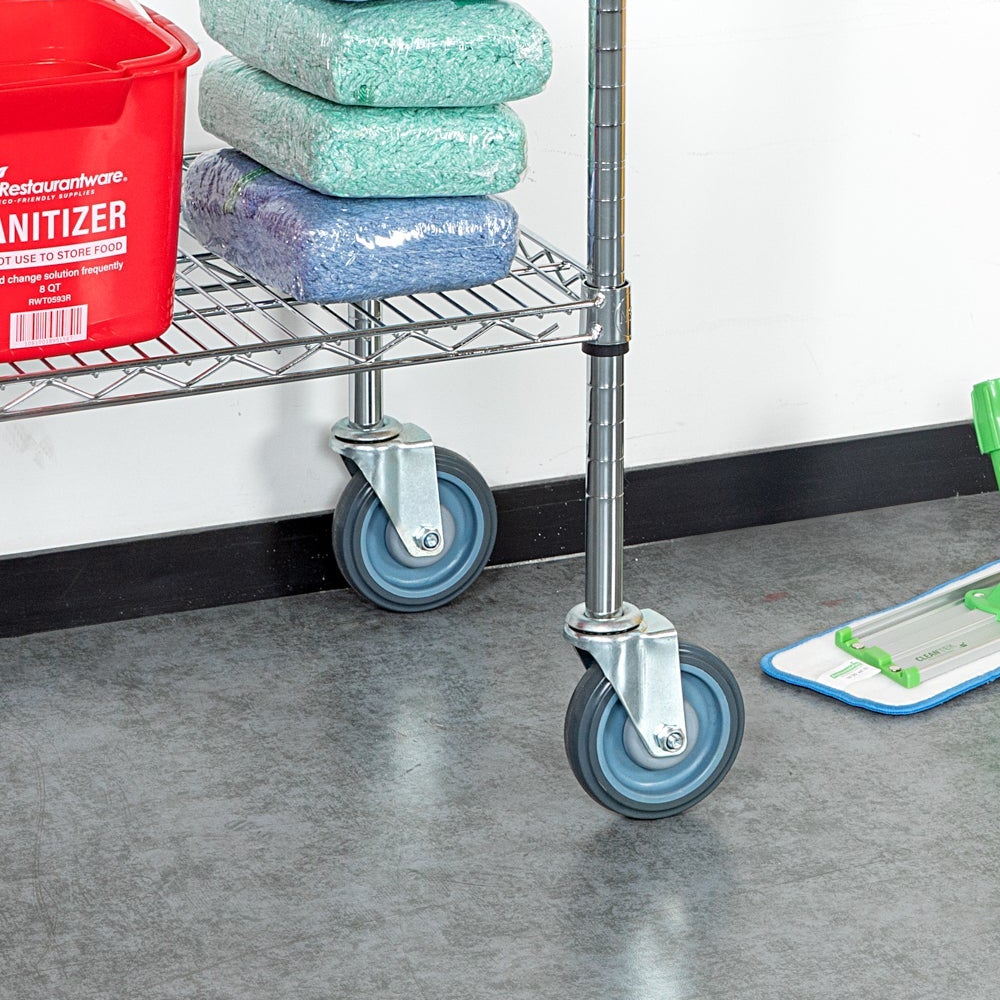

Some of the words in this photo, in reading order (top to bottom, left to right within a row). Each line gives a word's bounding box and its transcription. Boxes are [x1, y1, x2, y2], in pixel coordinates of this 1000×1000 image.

[0, 194, 56, 205] CO-FRIENDLY
[58, 189, 95, 199] SUPPLIES
[15, 254, 37, 264] USE
[40, 252, 54, 262] TO
[57, 246, 91, 260] STORE
[94, 241, 123, 255] FOOD
[8, 273, 42, 284] change
[44, 268, 80, 280] solution
[81, 260, 124, 275] frequently
[39, 285, 46, 293] 8
[48, 282, 62, 293] QT
[28, 294, 72, 306] RWT0593R
